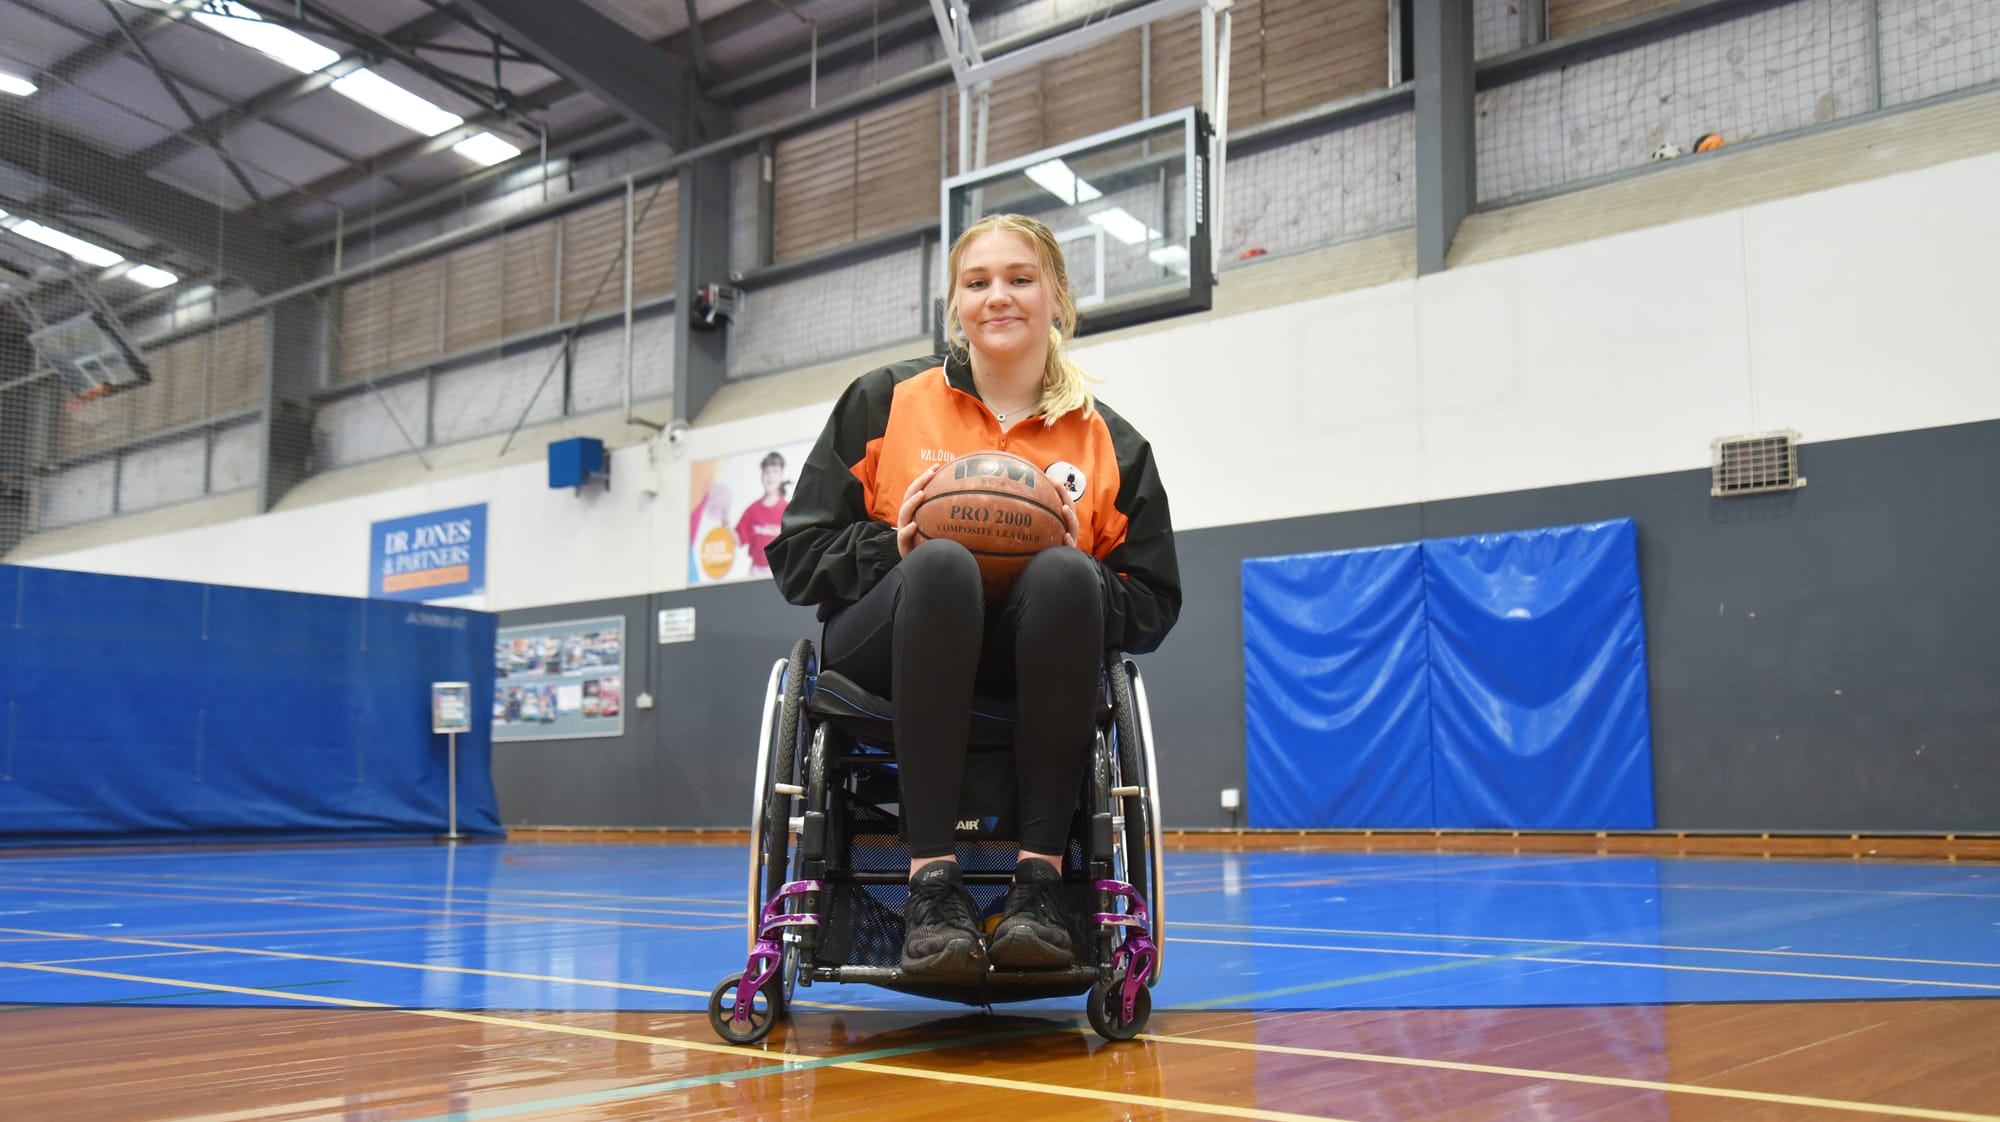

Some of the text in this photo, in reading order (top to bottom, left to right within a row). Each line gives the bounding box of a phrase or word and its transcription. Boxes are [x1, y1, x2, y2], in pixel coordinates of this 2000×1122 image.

[950, 505, 1033, 528] PRO 2000
[384, 518, 472, 555] DR JONES
[937, 523, 1040, 544] COMPOSITE LEATHER
[382, 545, 470, 576] & PARTNERS
